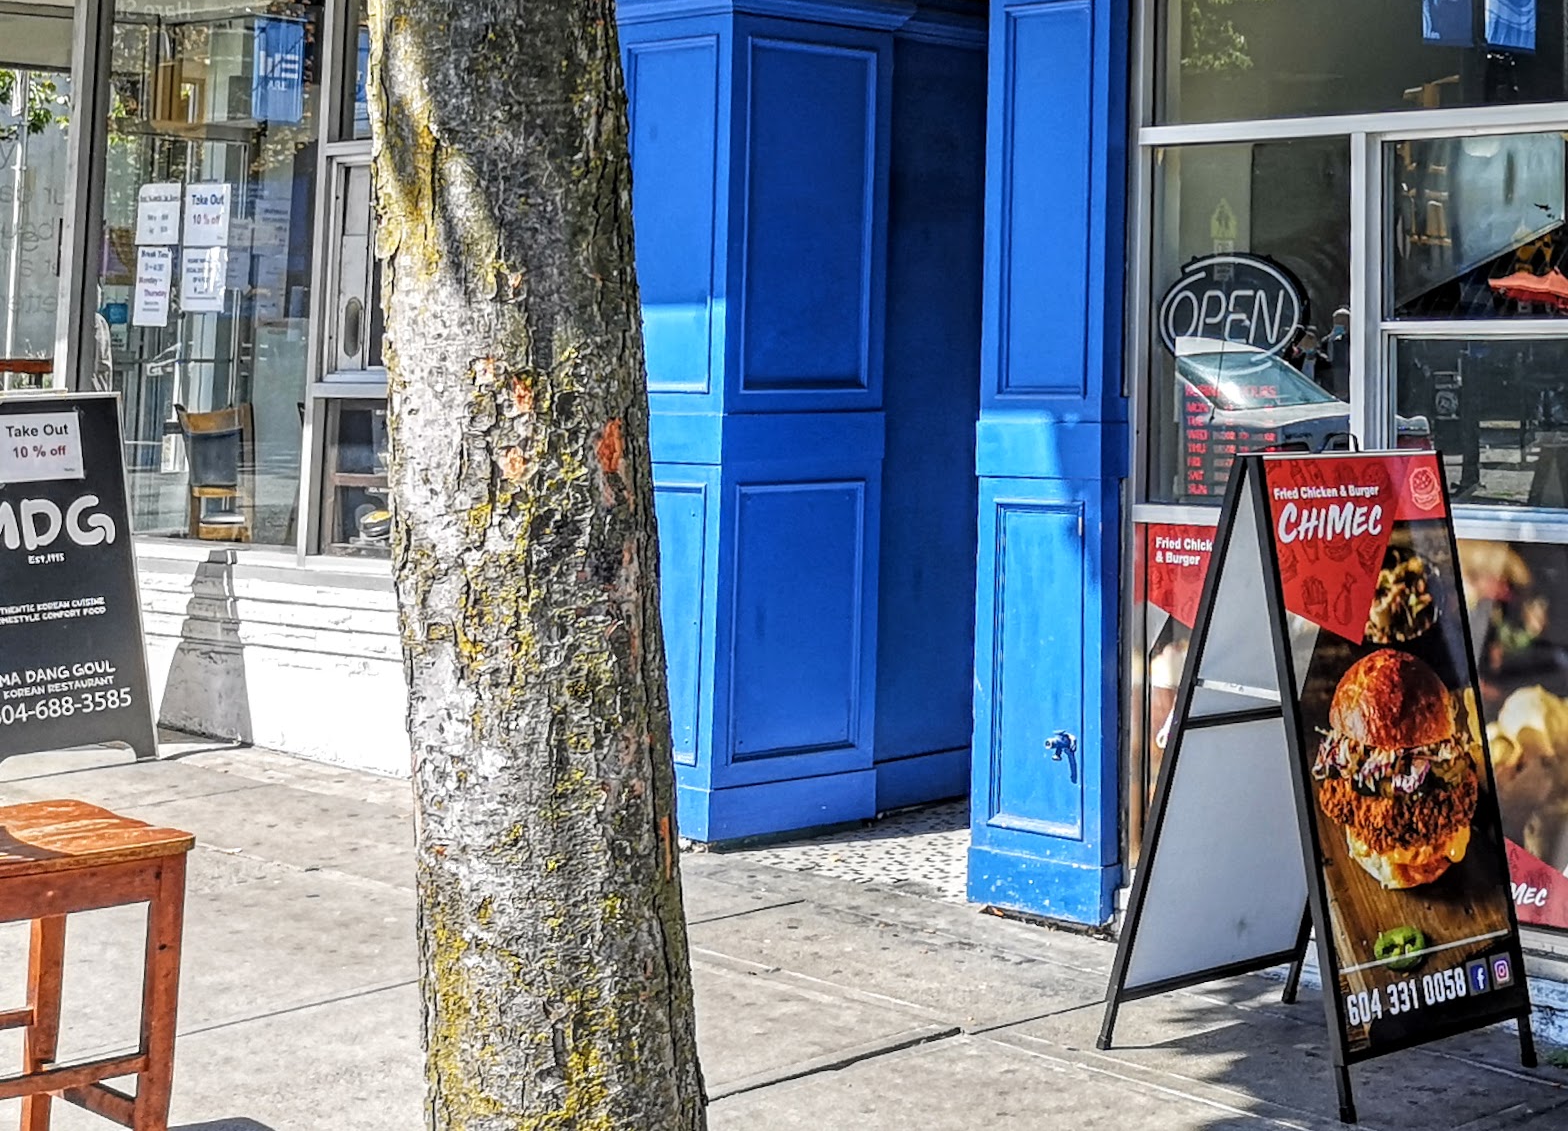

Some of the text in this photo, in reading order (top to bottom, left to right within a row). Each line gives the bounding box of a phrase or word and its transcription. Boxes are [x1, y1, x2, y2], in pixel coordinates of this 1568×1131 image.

[191, 194, 208, 206] Take
[209, 193, 224, 205] Out
[1168, 289, 1284, 344] OPEN
[6, 423, 69, 438] Take Out
[13, 445, 67, 458] 10 % off
[1273, 484, 1379, 500] Fried Chicken & Burger
[1155, 536, 1213, 552] Fried Chick
[1165, 551, 1201, 567] Burger
[37, 600, 70, 612] KOREAN
[71, 596, 106, 608] CUISINE
[83, 606, 107, 617] FOOD
[25, 665, 70, 684] DANG
[72, 659, 116, 677] GOUL
[3, 675, 115, 700] KOREAN RESTAURANT
[0, 687, 132, 725] 04-688-3585
[1346, 967, 1467, 1027] 604 331 0058
